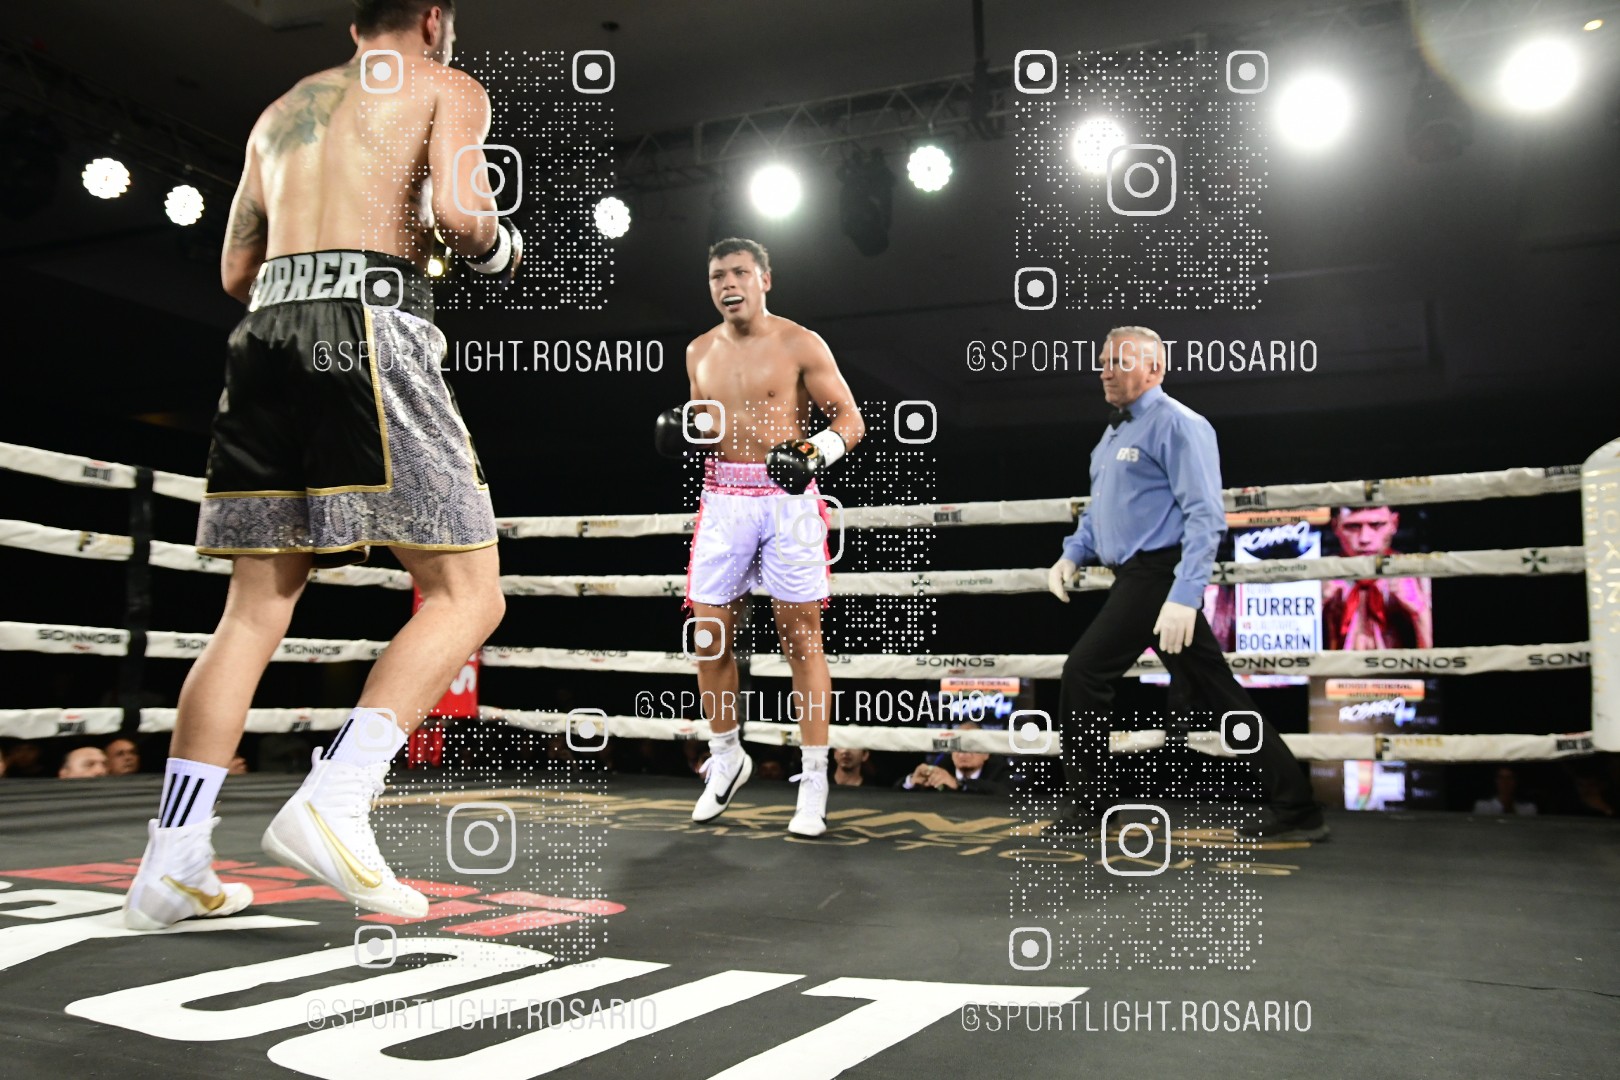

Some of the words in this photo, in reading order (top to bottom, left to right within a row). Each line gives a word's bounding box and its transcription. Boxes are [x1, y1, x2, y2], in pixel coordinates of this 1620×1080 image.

[1247, 597, 1315, 616] FURRER
[38, 628, 122, 645] SONNOS
[916, 656, 996, 668] SONNOS
[1365, 656, 1468, 669] SONNOS
